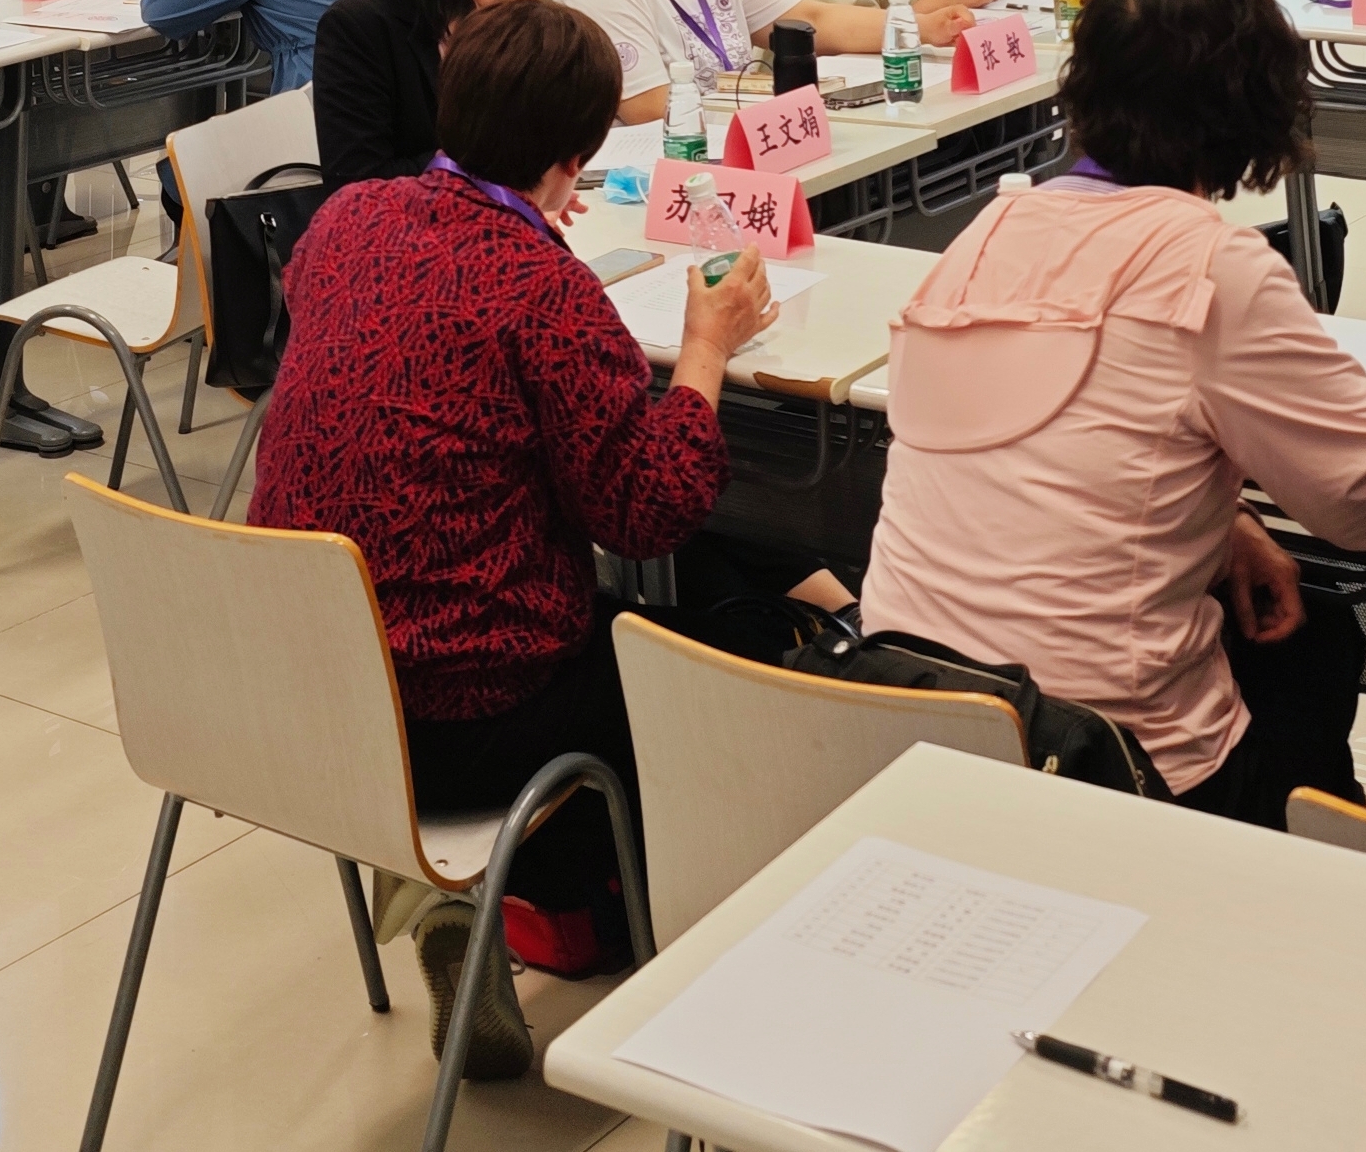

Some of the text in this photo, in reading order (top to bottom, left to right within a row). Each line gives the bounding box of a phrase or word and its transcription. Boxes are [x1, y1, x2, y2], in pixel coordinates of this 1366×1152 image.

[979, 31, 1026, 72] 张敏
[756, 105, 821, 156] 王文娟
